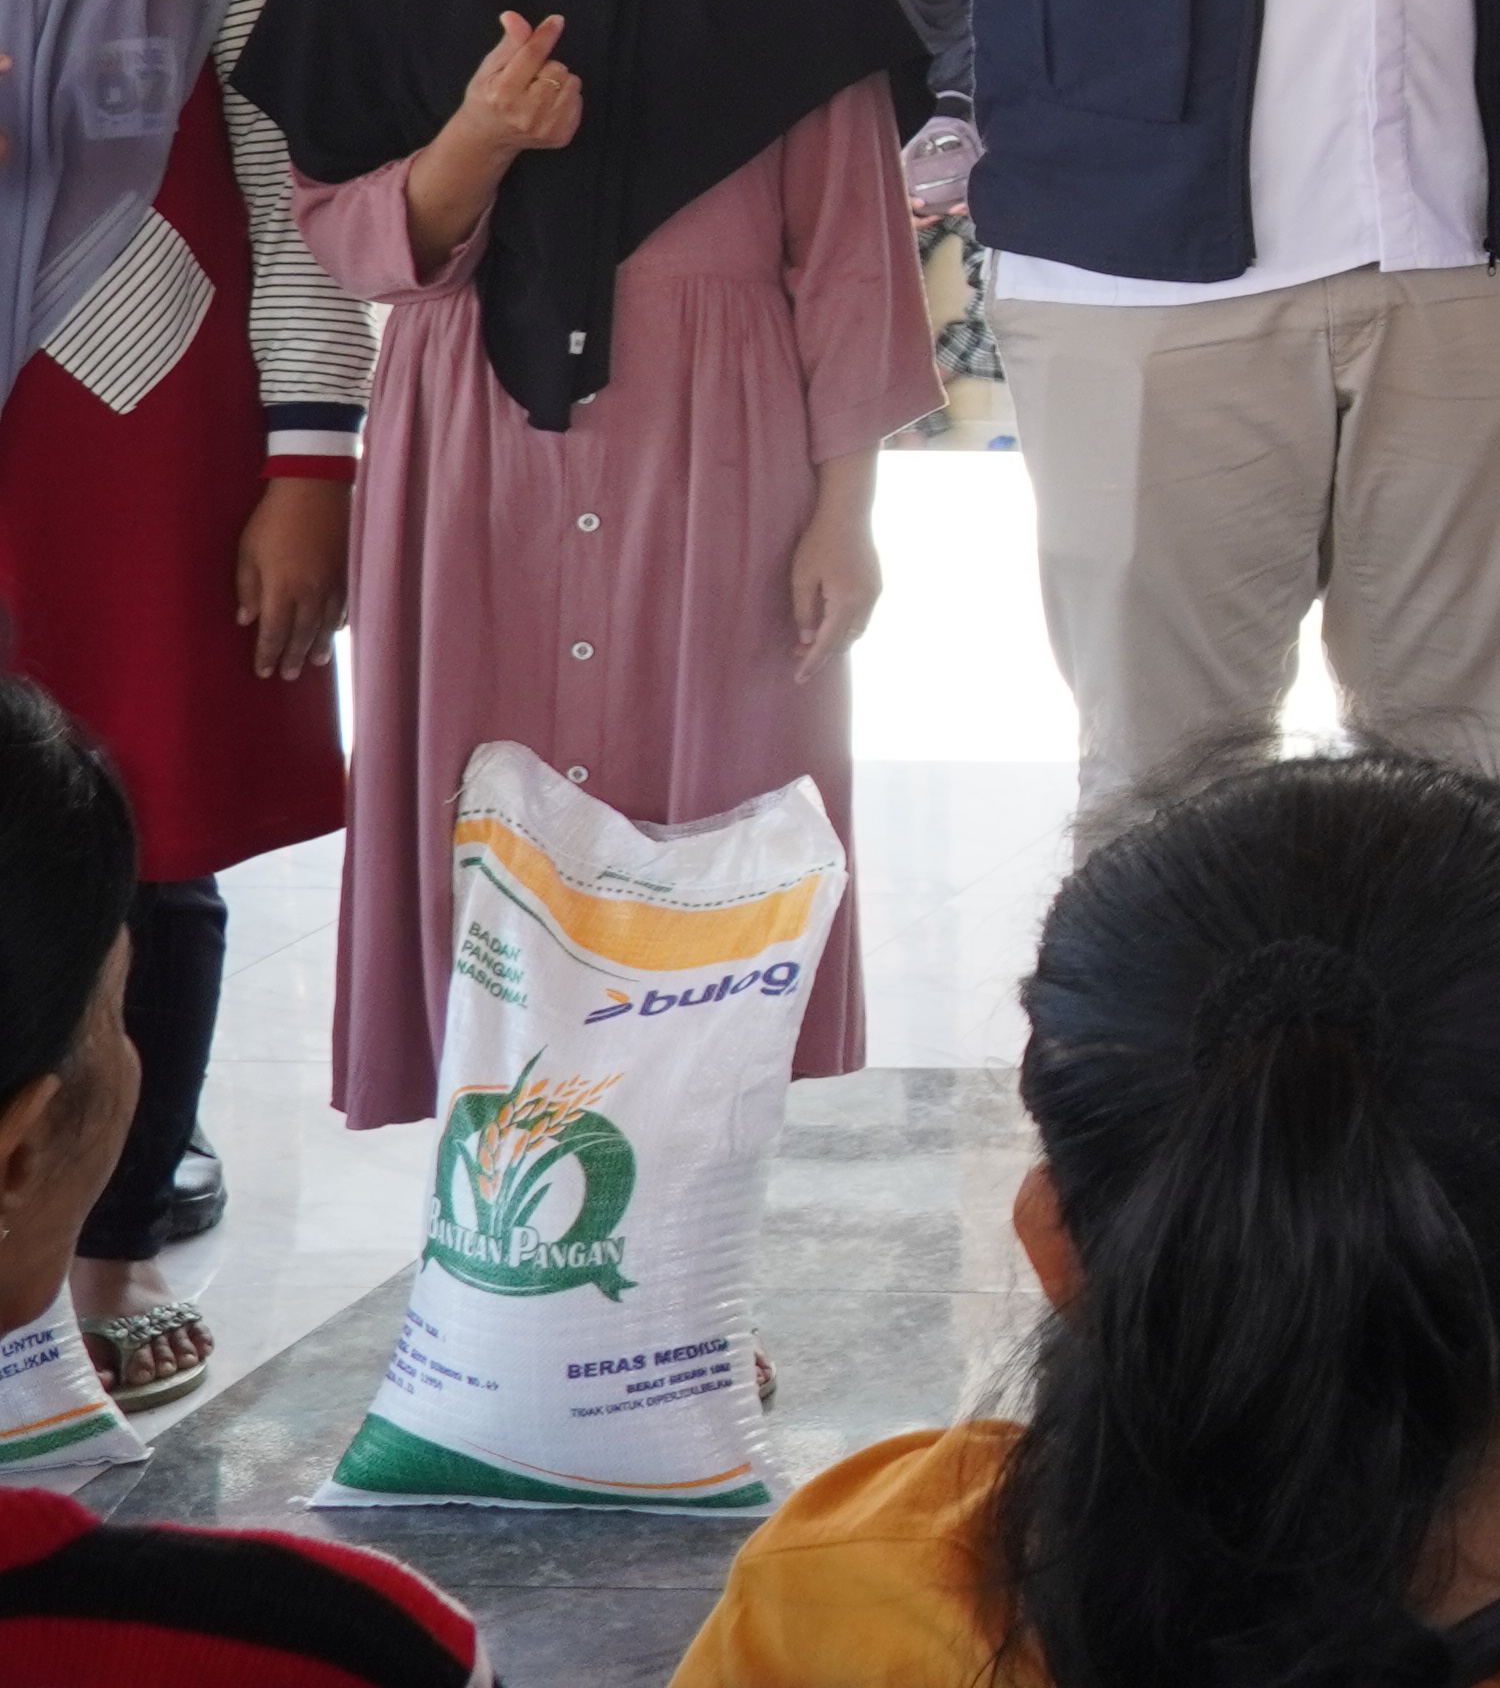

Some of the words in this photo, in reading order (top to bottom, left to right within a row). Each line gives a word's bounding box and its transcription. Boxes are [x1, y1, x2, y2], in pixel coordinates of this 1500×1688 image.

[461, 940, 524, 984] PANGAN
[468, 920, 521, 961] BADAN
[638, 961, 800, 1016] bulog
[428, 1194, 503, 1264] BANTUAN
[507, 1225, 626, 1269] PANGAN
[567, 1354, 647, 1379] BERAS
